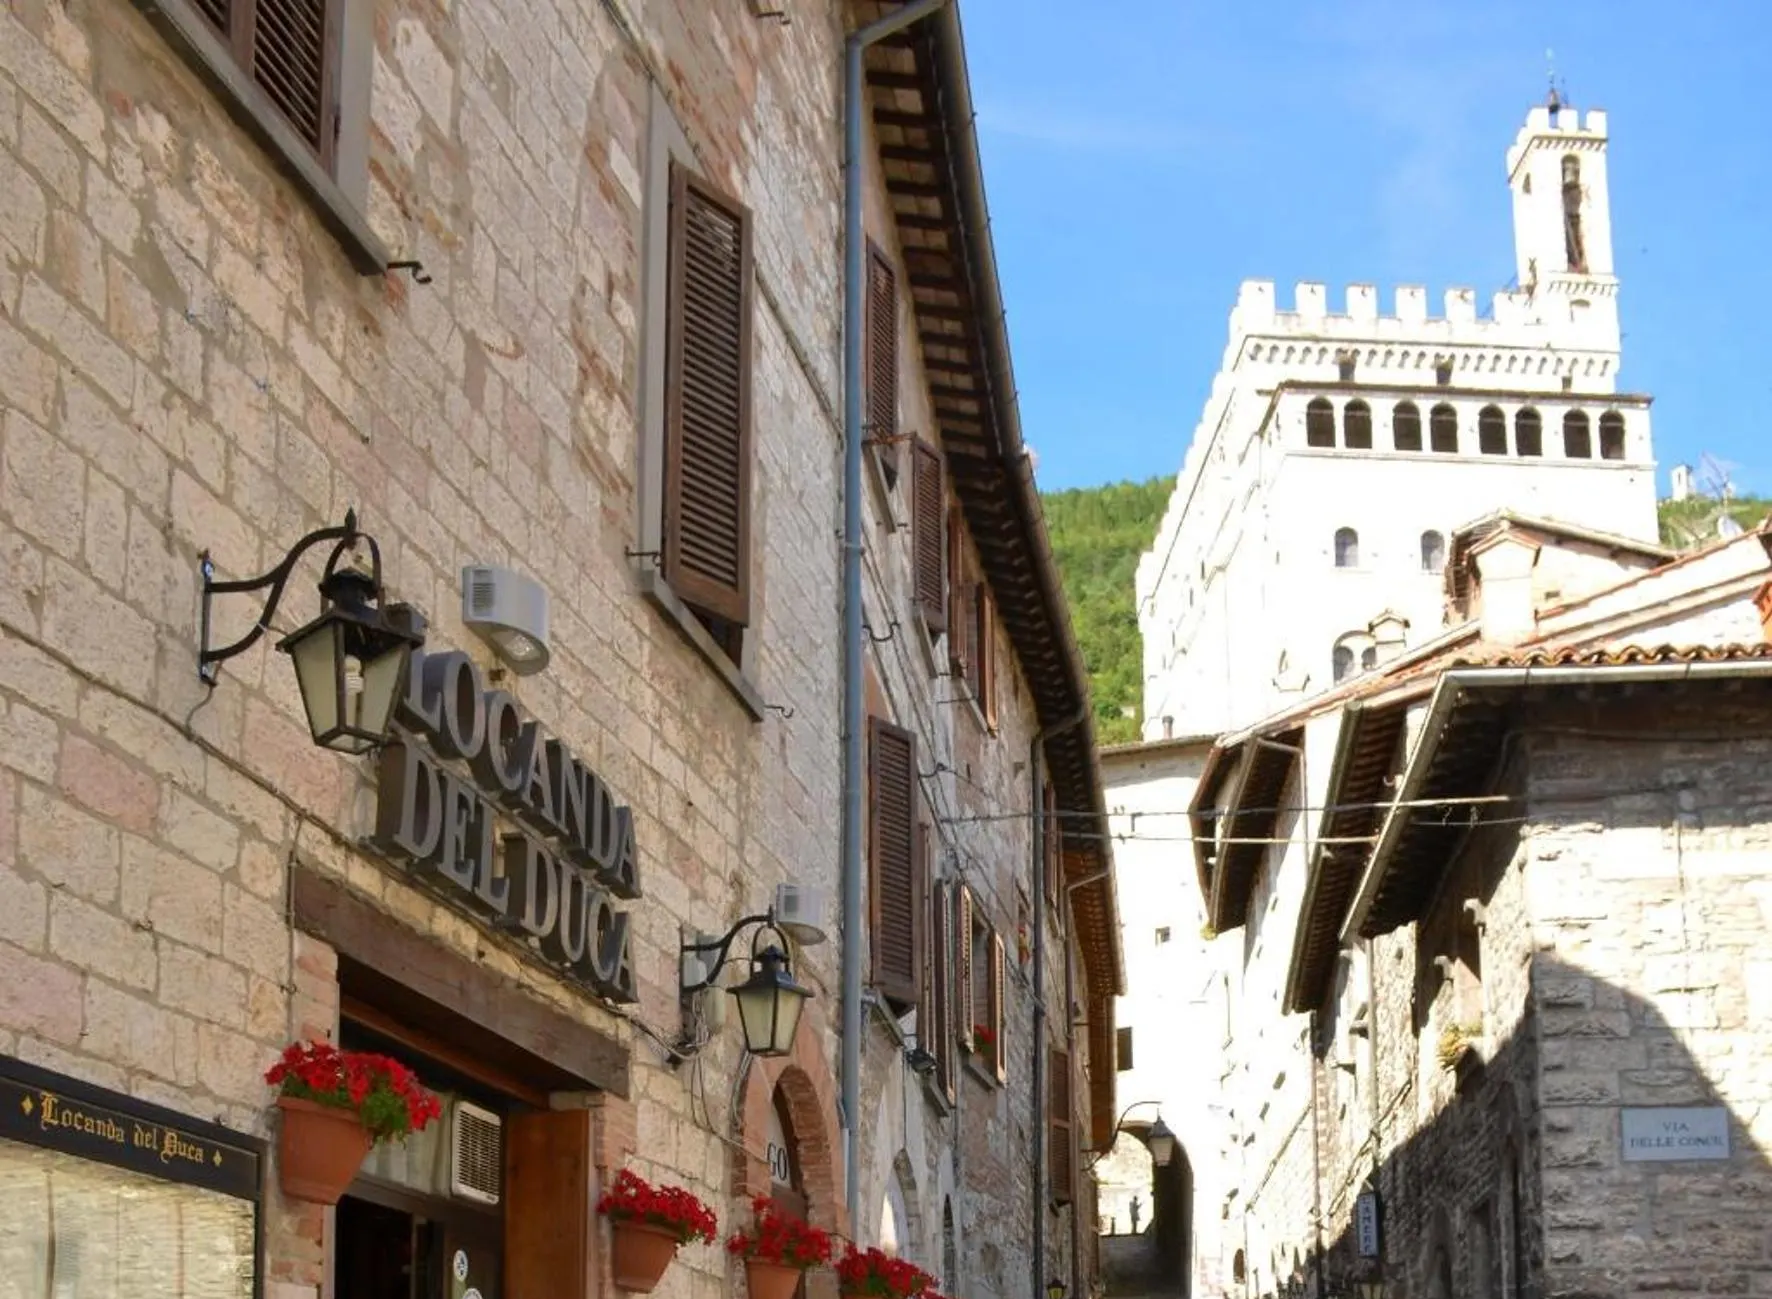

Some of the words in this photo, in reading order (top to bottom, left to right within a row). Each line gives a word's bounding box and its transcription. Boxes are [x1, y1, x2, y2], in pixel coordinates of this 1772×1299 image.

[403, 650, 642, 899] LOCANDA
[393, 721, 510, 916] DEL
[522, 834, 639, 1003] DUCA
[40, 1090, 125, 1143] Locanda
[133, 1122, 158, 1151] del
[160, 1126, 205, 1165] Duca
[1662, 1121, 1690, 1133] VIA
